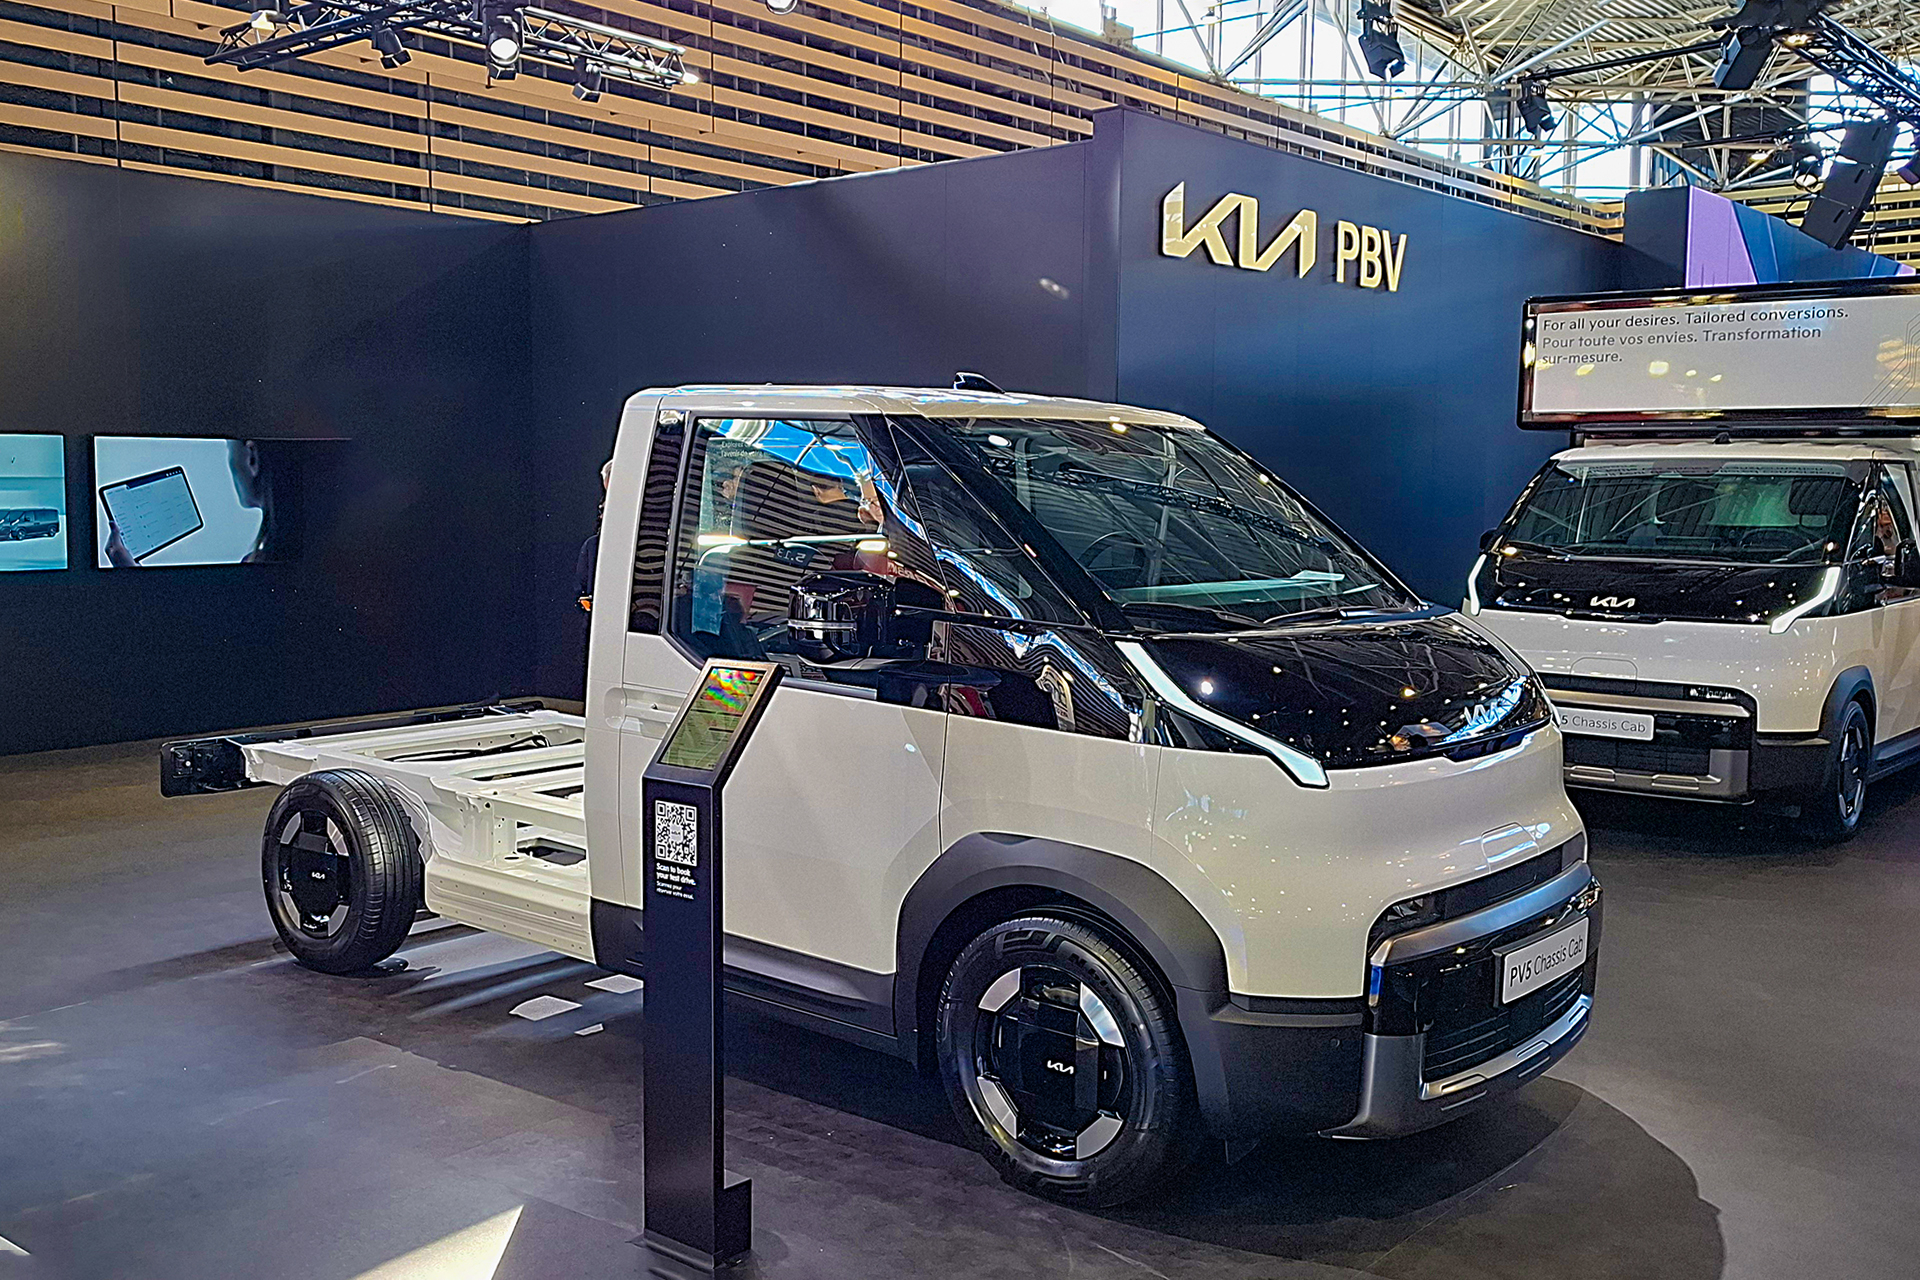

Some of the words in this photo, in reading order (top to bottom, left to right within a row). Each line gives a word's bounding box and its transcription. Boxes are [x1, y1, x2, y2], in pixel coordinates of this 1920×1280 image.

[1162, 180, 1317, 279] KIA
[1335, 219, 1408, 292] PBV
[1543, 319, 1566, 331] For
[1569, 317, 1585, 330] all
[1589, 318, 1621, 332] your
[1625, 314, 1680, 327] desires.
[1684, 309, 1746, 325] Tailored
[1750, 306, 1849, 322] conversions.
[1542, 337, 1575, 349] Pour
[1579, 335, 1615, 347] toute
[1620, 335, 1643, 346] vos
[1647, 330, 1698, 344] envies.
[1702, 326, 1822, 342] Transformation
[1542, 352, 1623, 365] sur-mesure.
[1590, 596, 1636, 608] KIA
[1572, 715, 1617, 730] Chassis
[1621, 720, 1646, 733] Cab
[656, 862, 669, 872] Scan
[670, 865, 676, 874] to
[677, 866, 691, 877] book
[1510, 959, 1533, 988] PV5
[1534, 944, 1567, 976] Chassis
[1568, 934, 1584, 958] Cab
[1047, 1059, 1075, 1075] KIA
